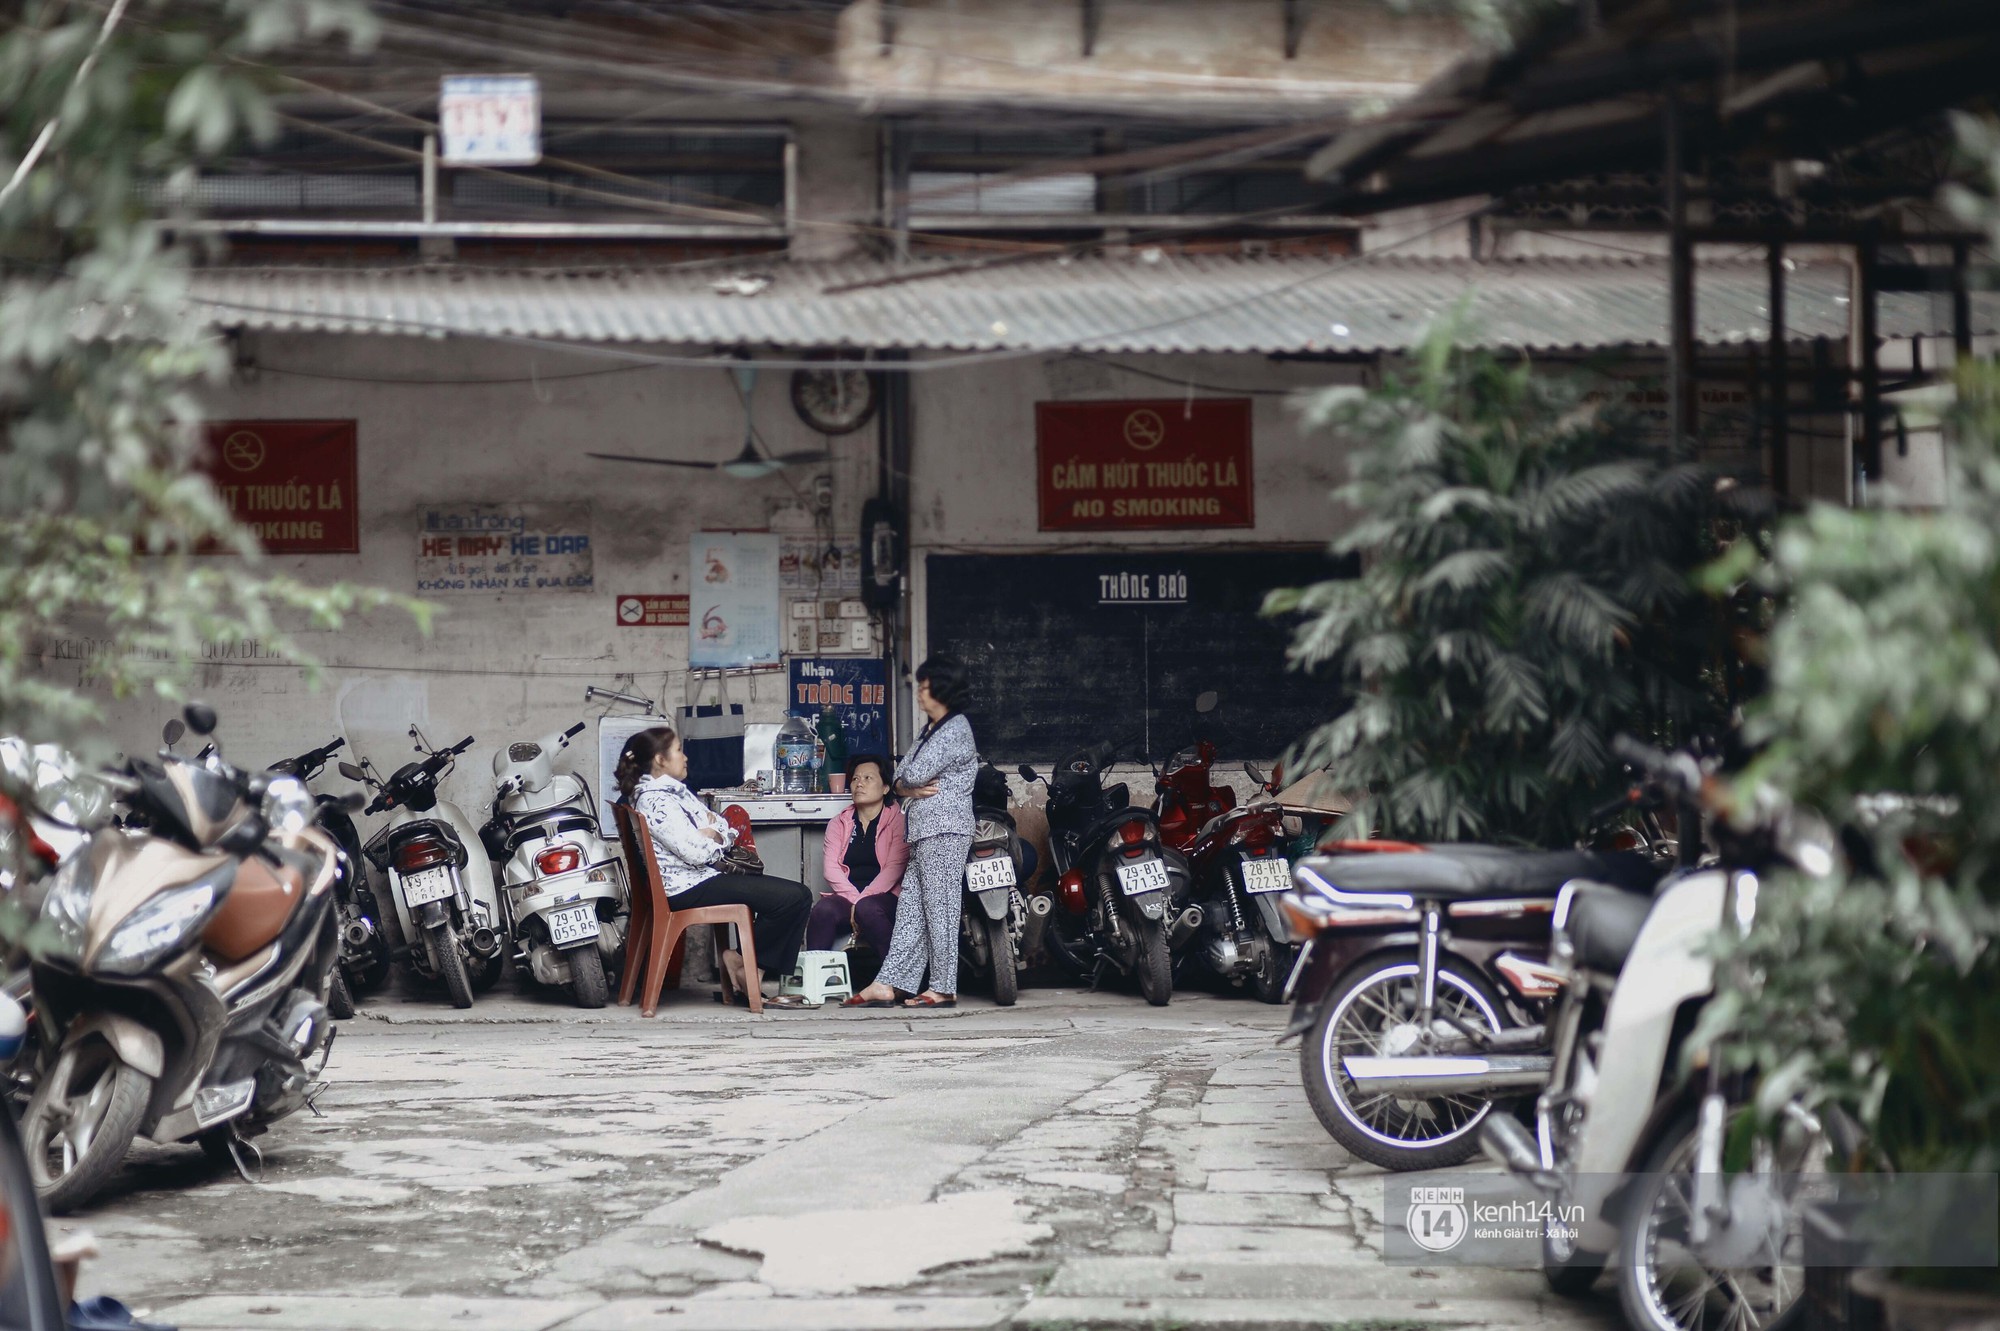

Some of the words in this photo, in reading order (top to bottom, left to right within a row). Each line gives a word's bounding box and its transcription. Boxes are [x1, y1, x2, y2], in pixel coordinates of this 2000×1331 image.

[1052, 454, 1097, 489] CẤM
[1103, 457, 1139, 488] HÚT
[1145, 453, 1208, 488] THUỐC
[1215, 456, 1238, 487] LÁ
[245, 475, 311, 511] THUỐC
[317, 478, 342, 510] LÁ
[1073, 499, 1105, 517] NO
[1112, 498, 1220, 517] SMOKING
[1099, 571, 1150, 599] THÔNG
[1158, 569, 1187, 599] BÁO
[801, 661, 834, 679] Nhận
[797, 679, 854, 704] TRÔNG
[1124, 862, 1158, 879] 29-B1
[1249, 862, 1282, 876] 28-H1
[1126, 873, 1166, 892] 471.35
[1248, 875, 1289, 890] 222.52
[554, 908, 588, 927] 29-D1
[554, 920, 596, 941] 055.86
